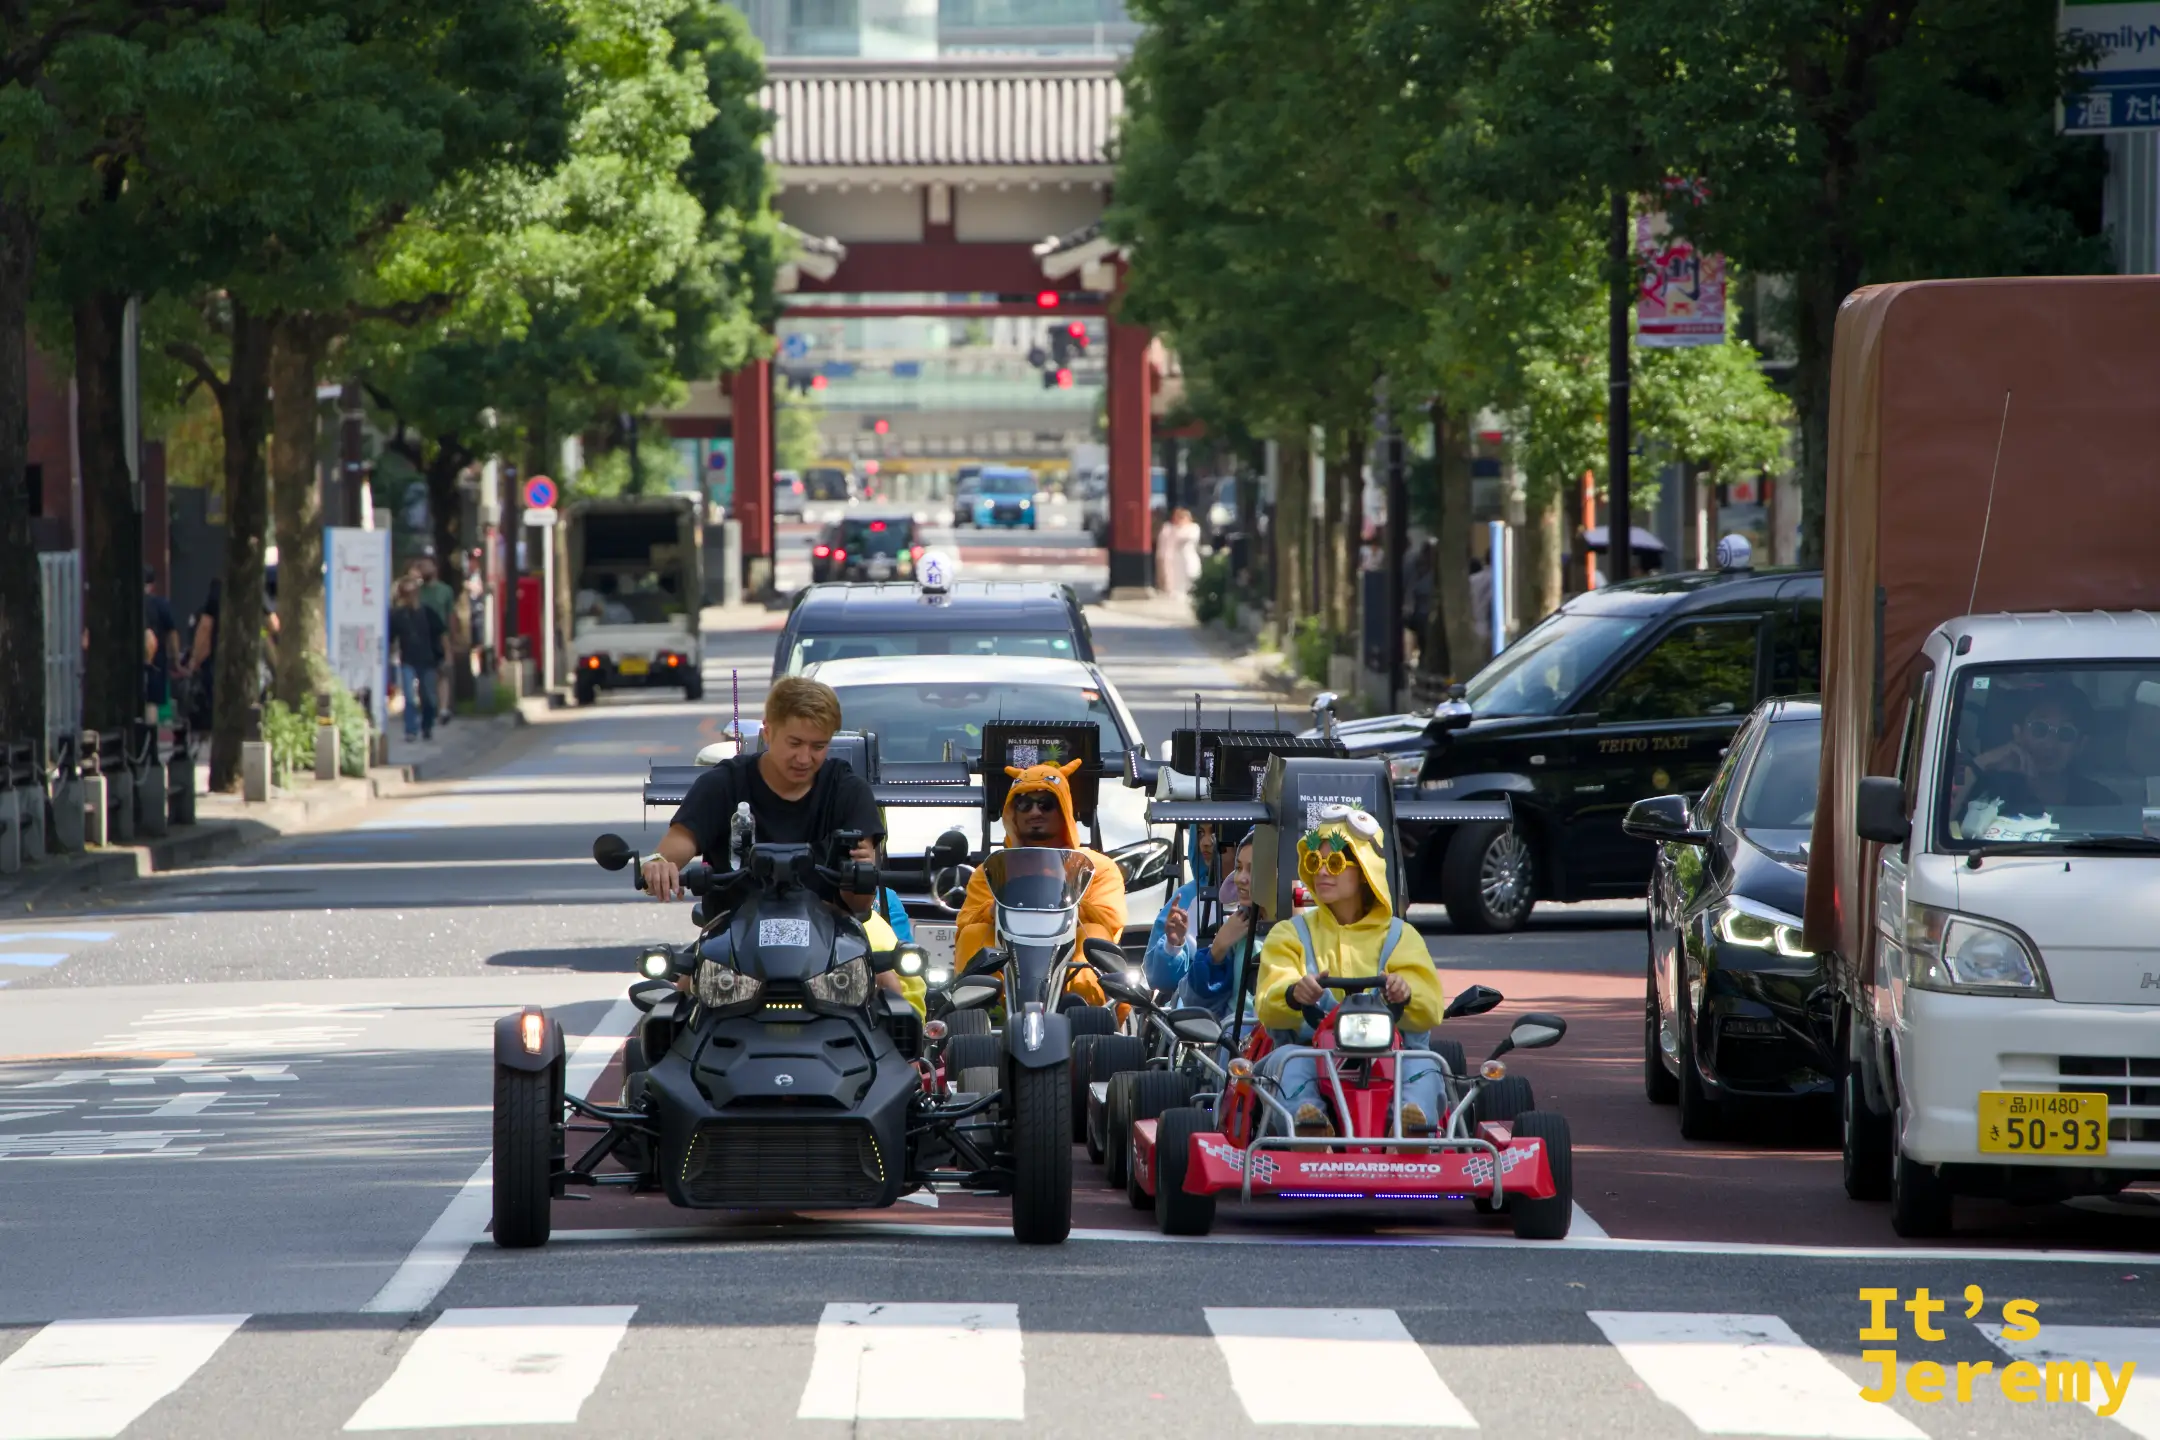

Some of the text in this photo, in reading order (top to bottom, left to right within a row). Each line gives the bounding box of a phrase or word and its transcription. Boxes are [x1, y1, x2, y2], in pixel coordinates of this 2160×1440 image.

[1598, 735, 1690, 753] TEITO TAXI
[2007, 1117, 2101, 1151] 50-93
[1299, 1162, 1442, 1174] STANDARDMOTO
